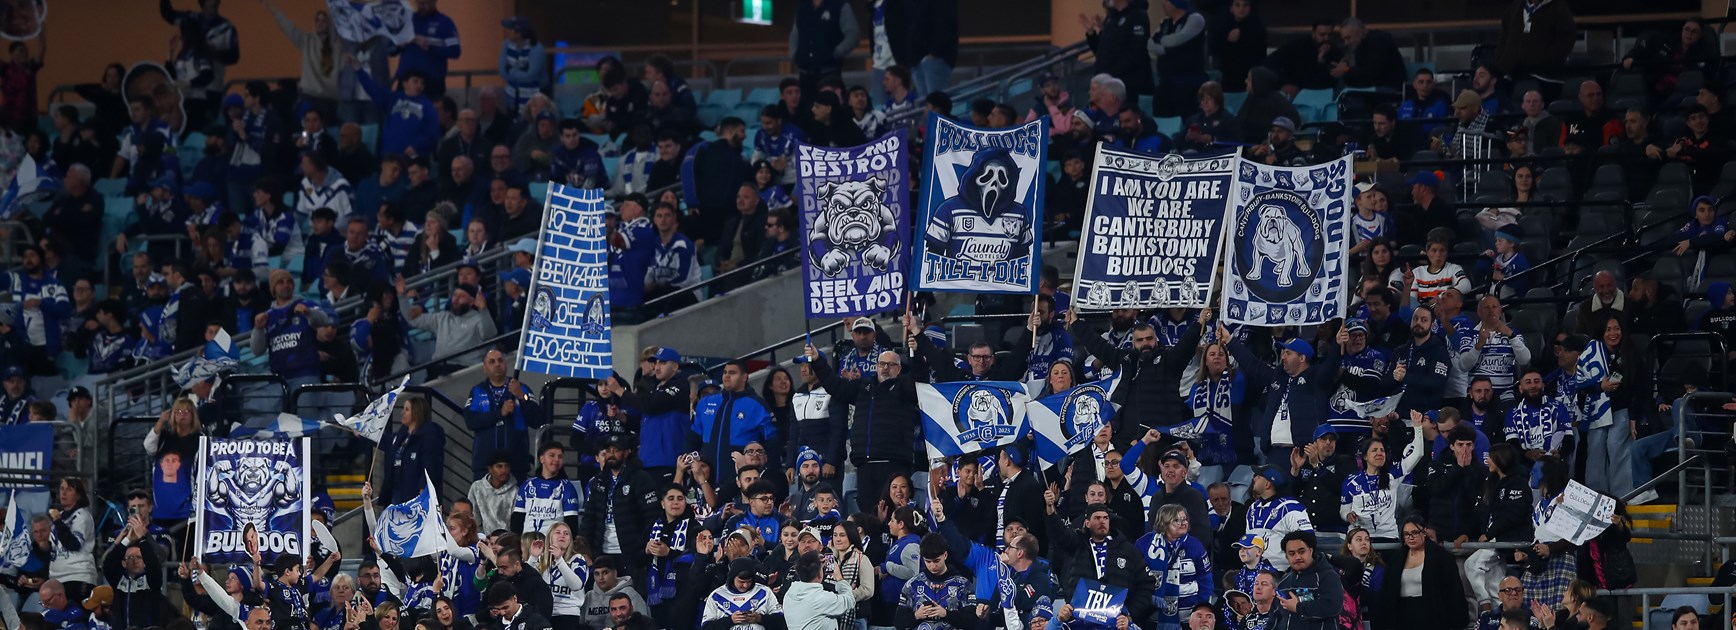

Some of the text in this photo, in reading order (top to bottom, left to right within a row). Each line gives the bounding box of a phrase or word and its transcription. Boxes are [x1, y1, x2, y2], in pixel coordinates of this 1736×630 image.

[799, 136, 900, 161] SEEK AND
[936, 120, 1041, 159] BULLDOGS
[801, 150, 899, 177] DESTROY
[1100, 175, 1109, 195] I
[1127, 197, 1154, 217] WE
[1093, 215, 1216, 238] CANTERBURY
[956, 237, 1012, 262] Laundy
[1092, 235, 1210, 257] BANKSTOWN
[1106, 256, 1198, 277] BULLDOGS
[810, 271, 904, 298] SEEK AND
[811, 287, 903, 314] DESTROY
[557, 303, 578, 324] OF
[210, 441, 296, 457] PROUD TO BE A
[529, 499, 557, 520] Laundy
[206, 532, 300, 555] BULDOG
[1085, 589, 1113, 611] TRY
